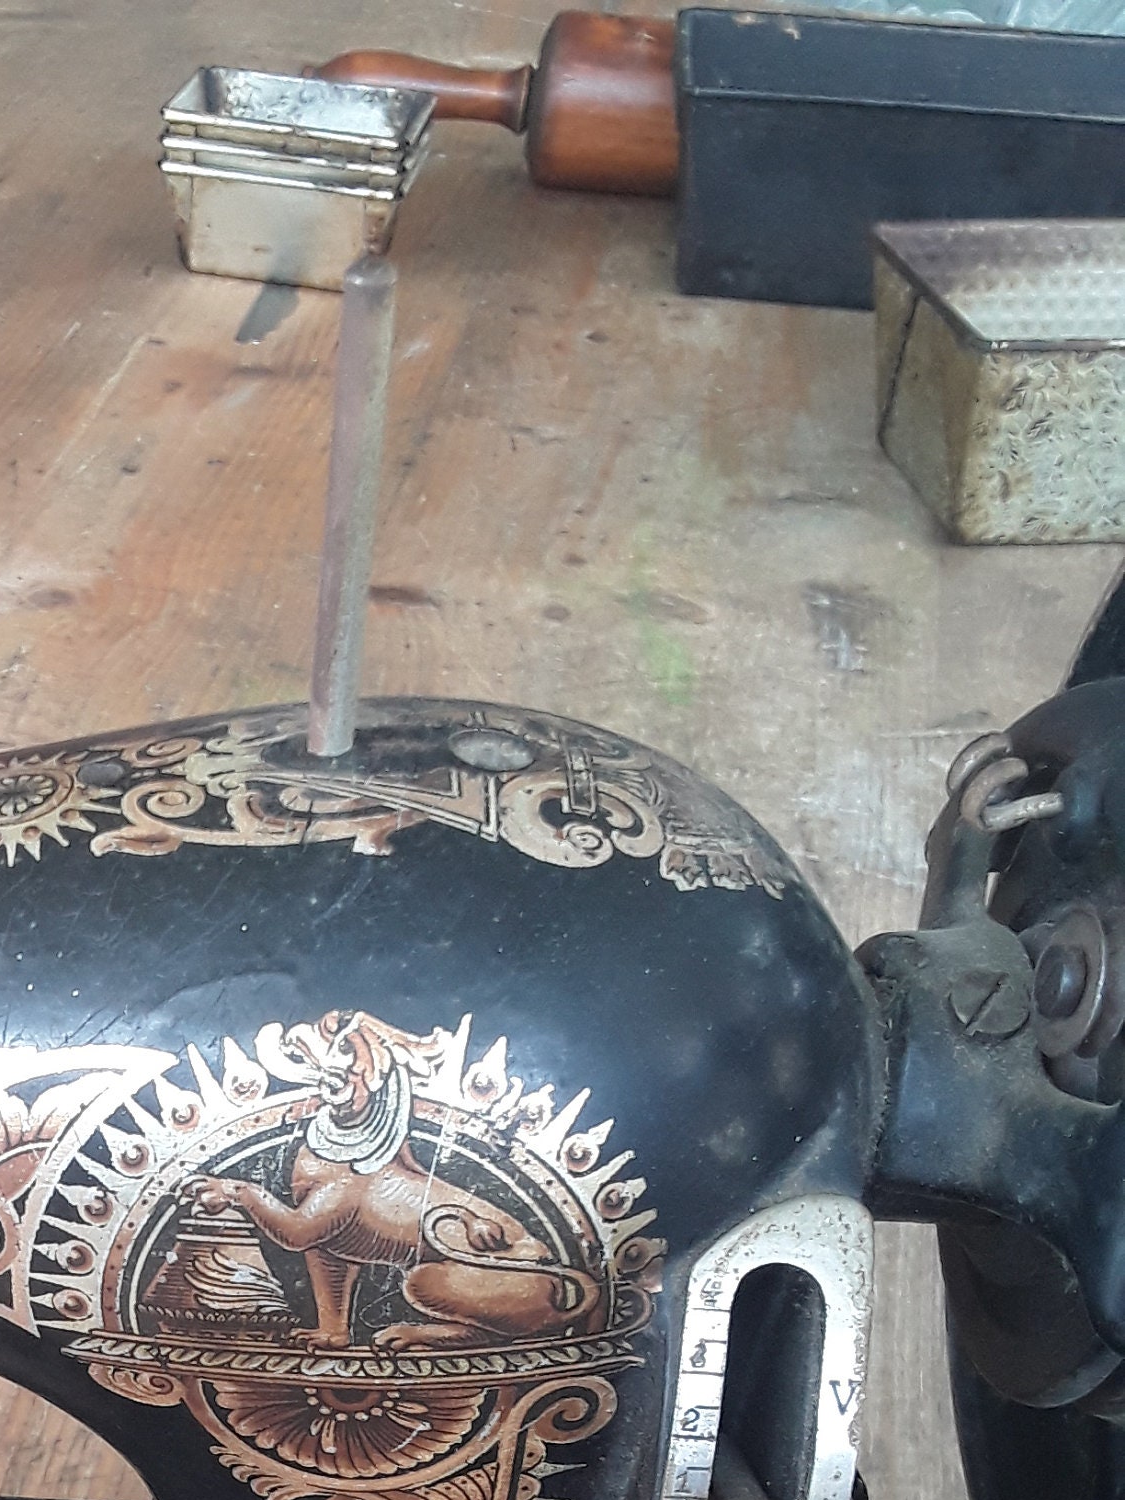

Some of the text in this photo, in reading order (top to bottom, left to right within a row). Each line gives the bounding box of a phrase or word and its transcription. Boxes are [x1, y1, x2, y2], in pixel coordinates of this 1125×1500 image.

[828, 1379, 861, 1415] V
[680, 1408, 701, 1432] 2
[674, 1471, 691, 1494] 1
